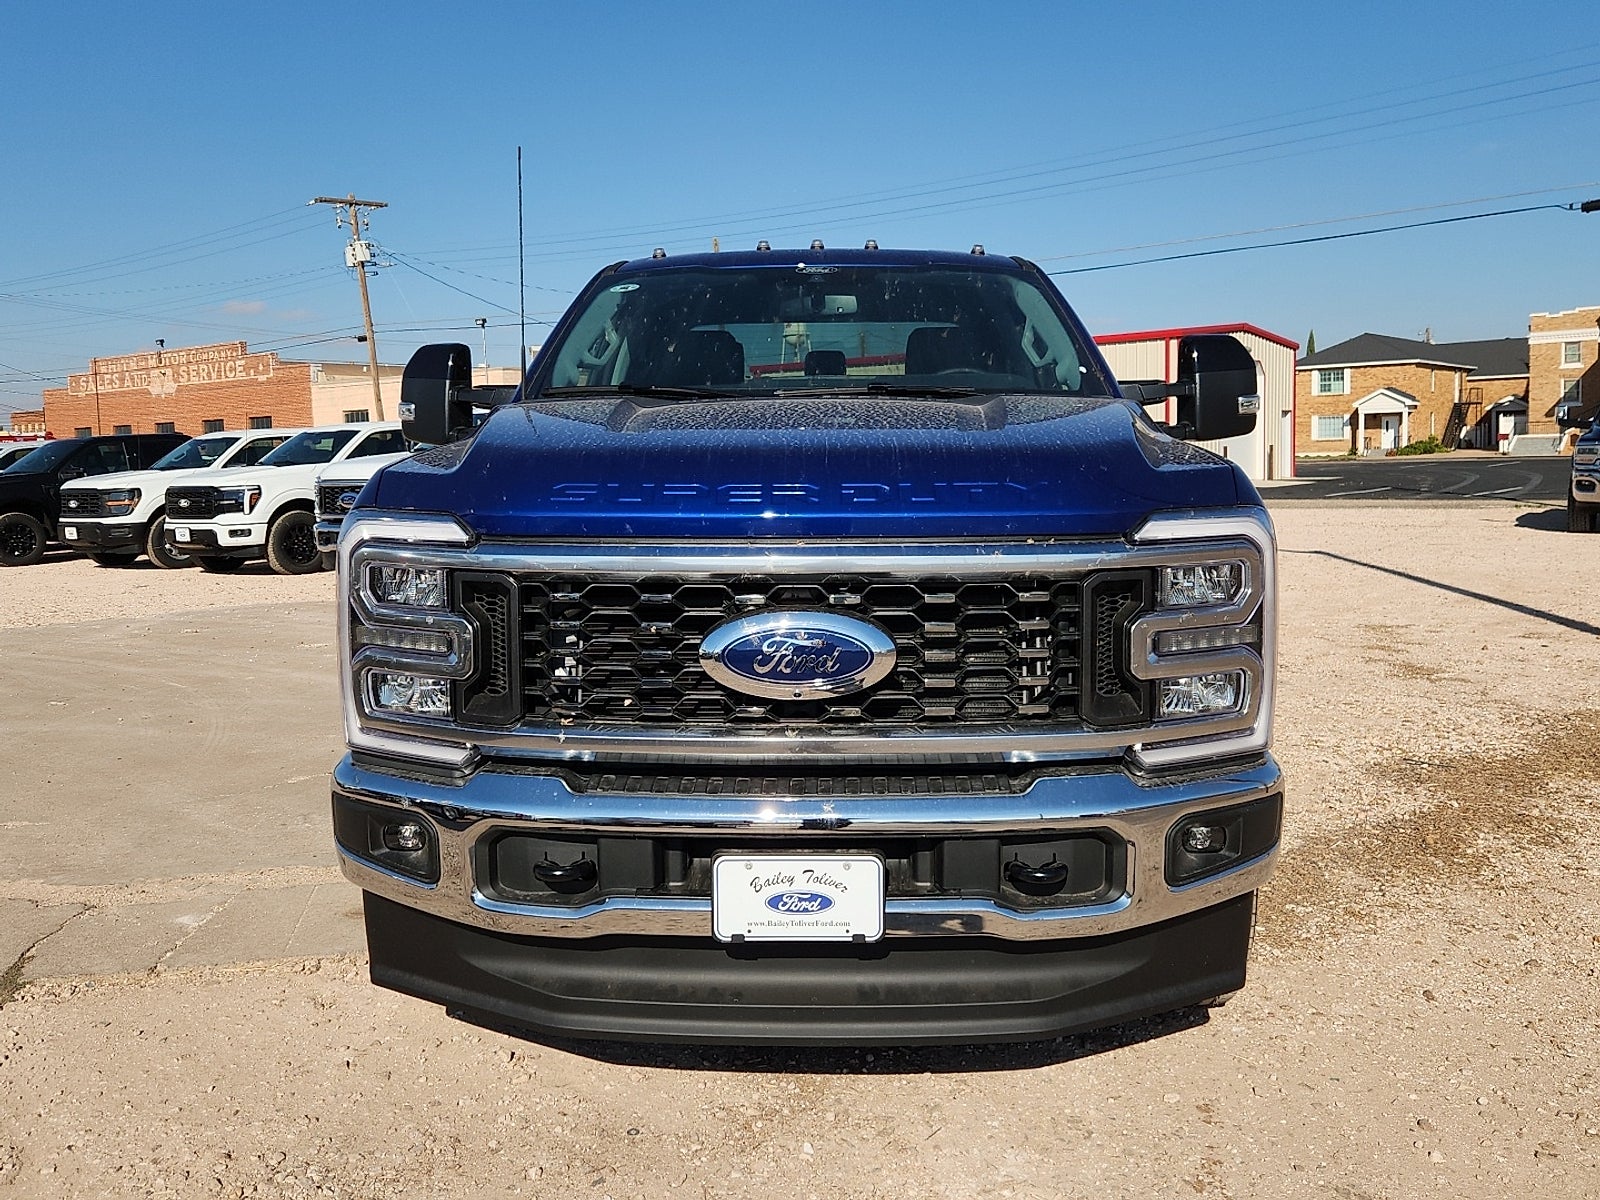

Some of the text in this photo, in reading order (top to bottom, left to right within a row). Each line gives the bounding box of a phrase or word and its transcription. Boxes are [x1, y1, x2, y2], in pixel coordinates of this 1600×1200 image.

[149, 352, 187, 367] MOTOR
[79, 373, 119, 392] SALES
[124, 371, 148, 388] AND
[550, 481, 1048, 502] SUPER DUTY
[753, 636, 838, 674] Ford
[750, 869, 848, 893] Bailey Toliver
[777, 893, 821, 911] Ford
[747, 919, 851, 928] www.BaileyToliverFord.com
